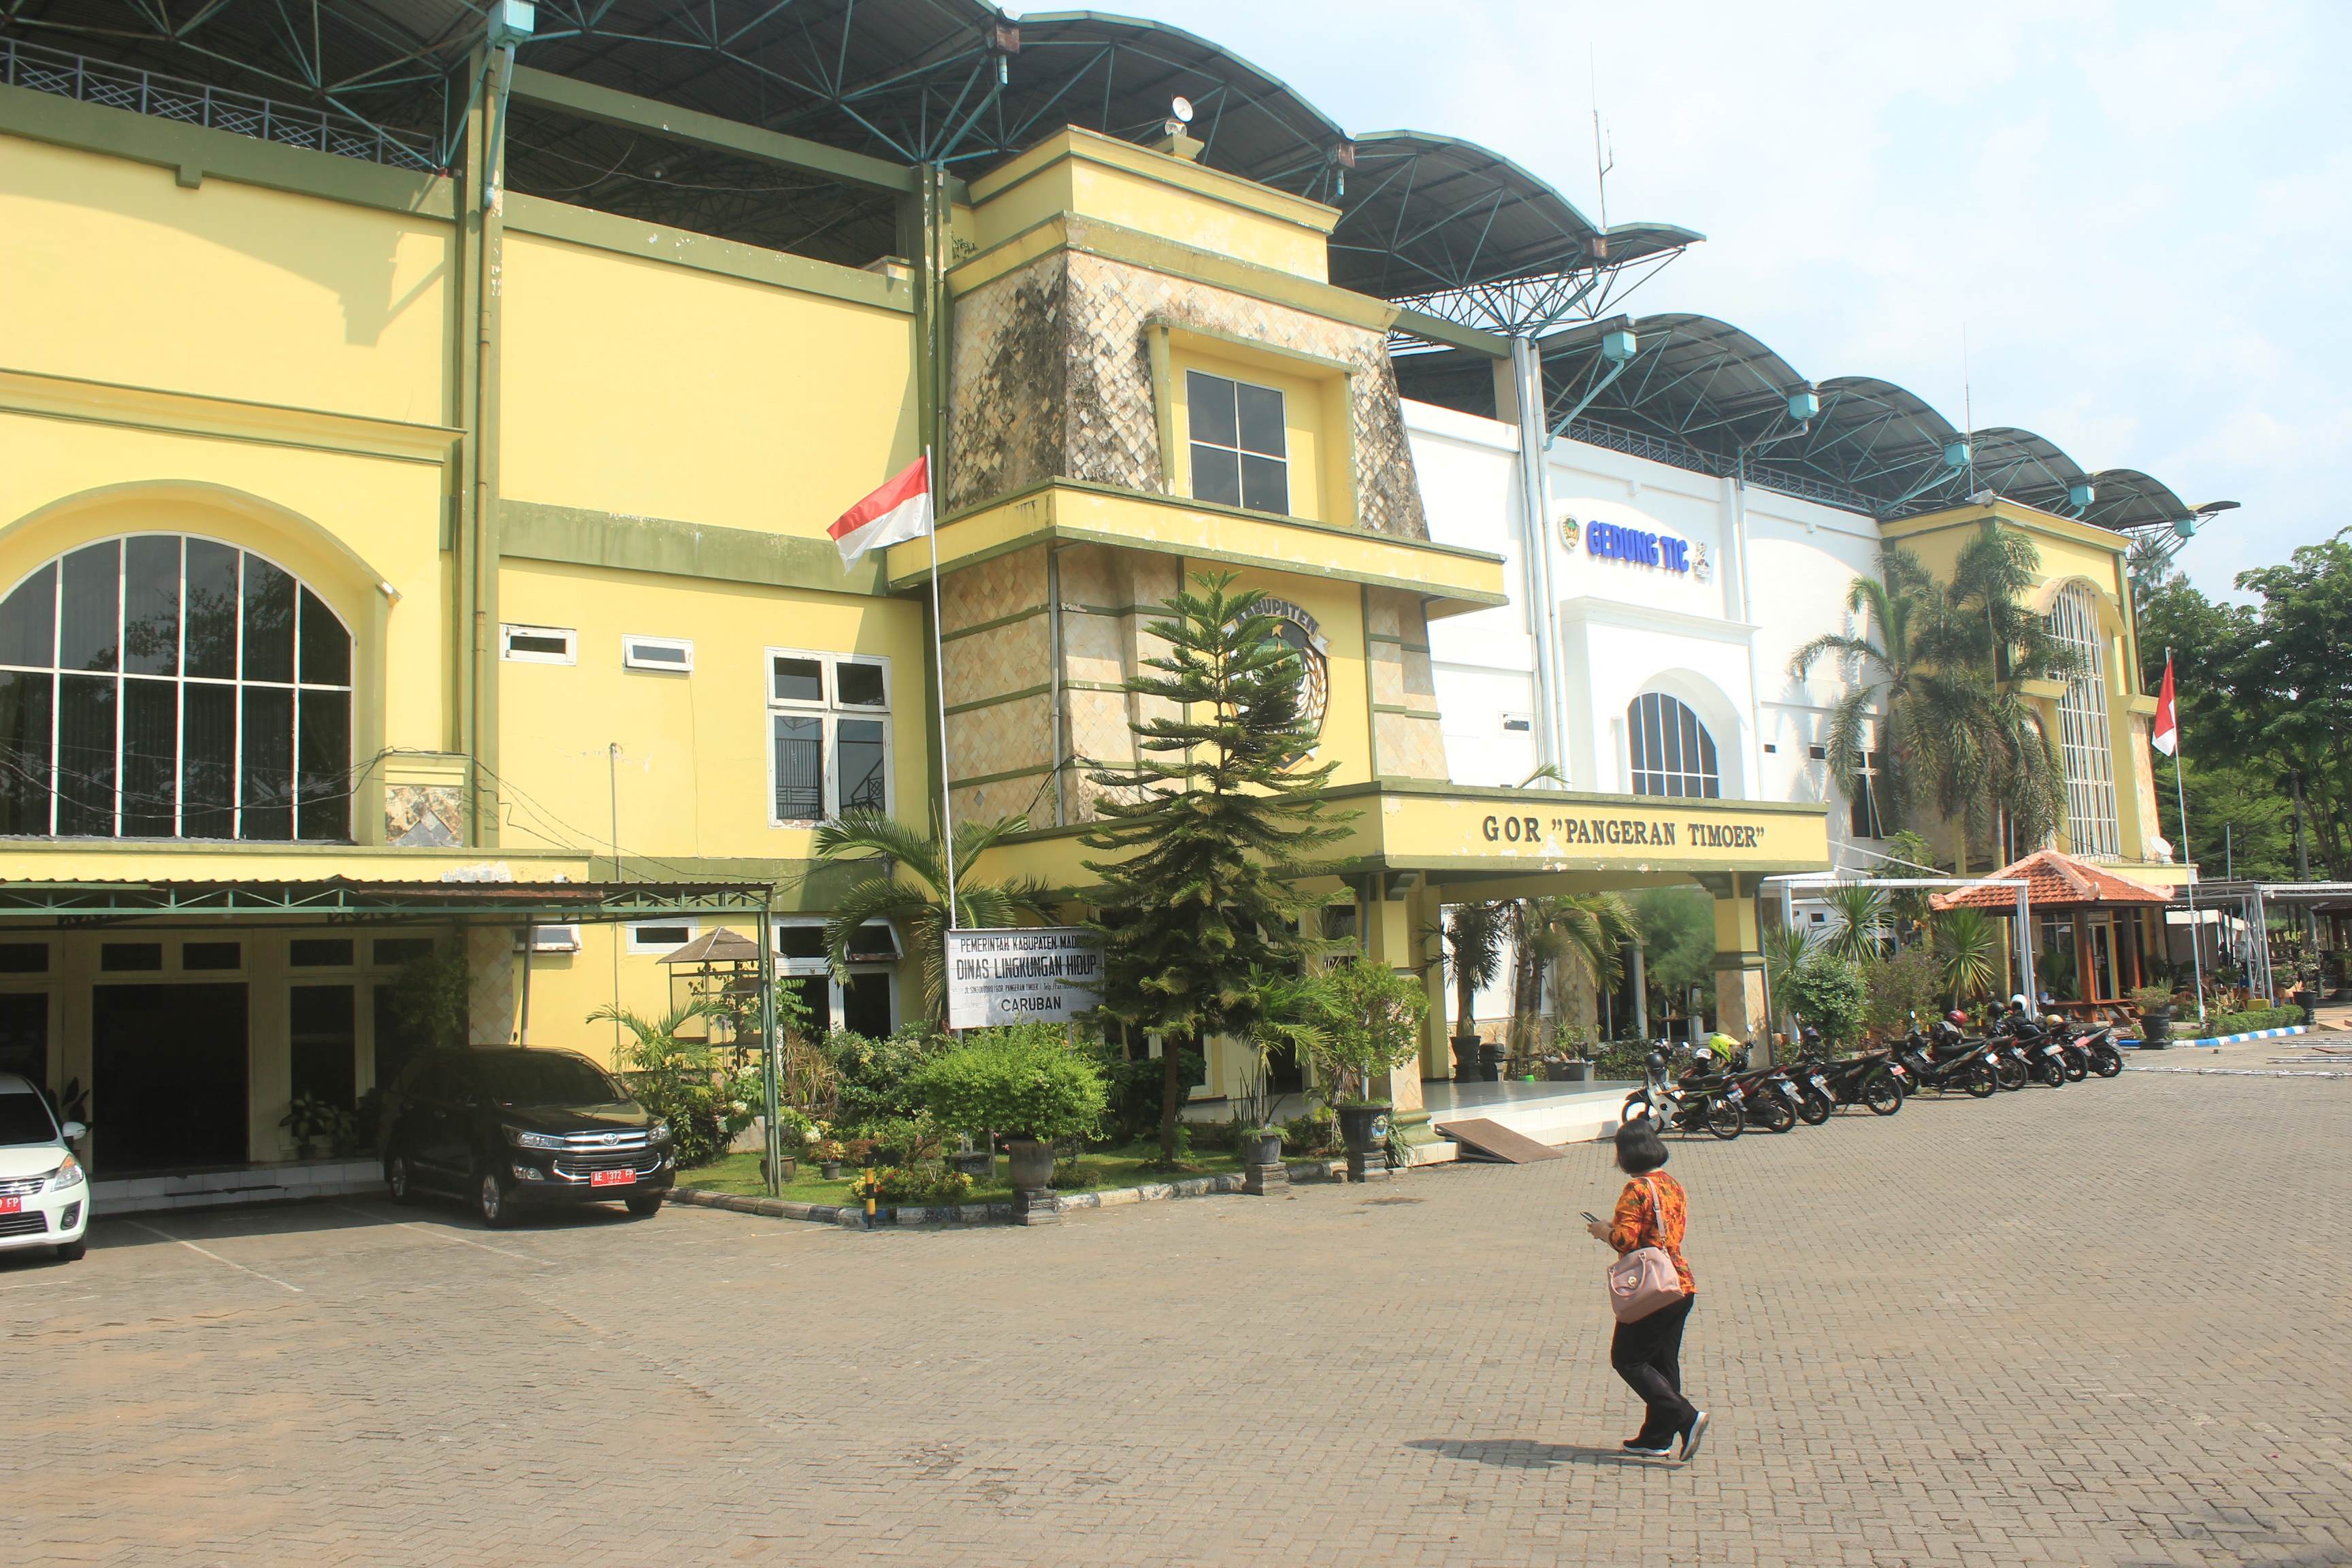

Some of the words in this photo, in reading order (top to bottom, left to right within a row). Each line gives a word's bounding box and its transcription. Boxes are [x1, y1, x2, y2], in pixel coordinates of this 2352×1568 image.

[1586, 521, 1659, 566] GEDUNG
[1660, 536, 1690, 572] TIC
[1482, 815, 1541, 842] GOR
[1551, 818, 1676, 845] "PANGERAN
[1687, 823, 1765, 847] TIMOER"
[961, 937, 1010, 953] PEMERINTAH
[1013, 935, 1058, 951] KABUPATEN
[956, 958, 990, 980] DINAS
[994, 955, 1062, 979] LINGKUNGAN
[1066, 954, 1096, 975] HIDUP
[1001, 996, 1061, 1012] CARUBAN
[594, 1172, 603, 1181] AE
[606, 1171, 621, 1180] 1372
[625, 1170, 634, 1178] FP
[7, 1197, 18, 1208] FP
